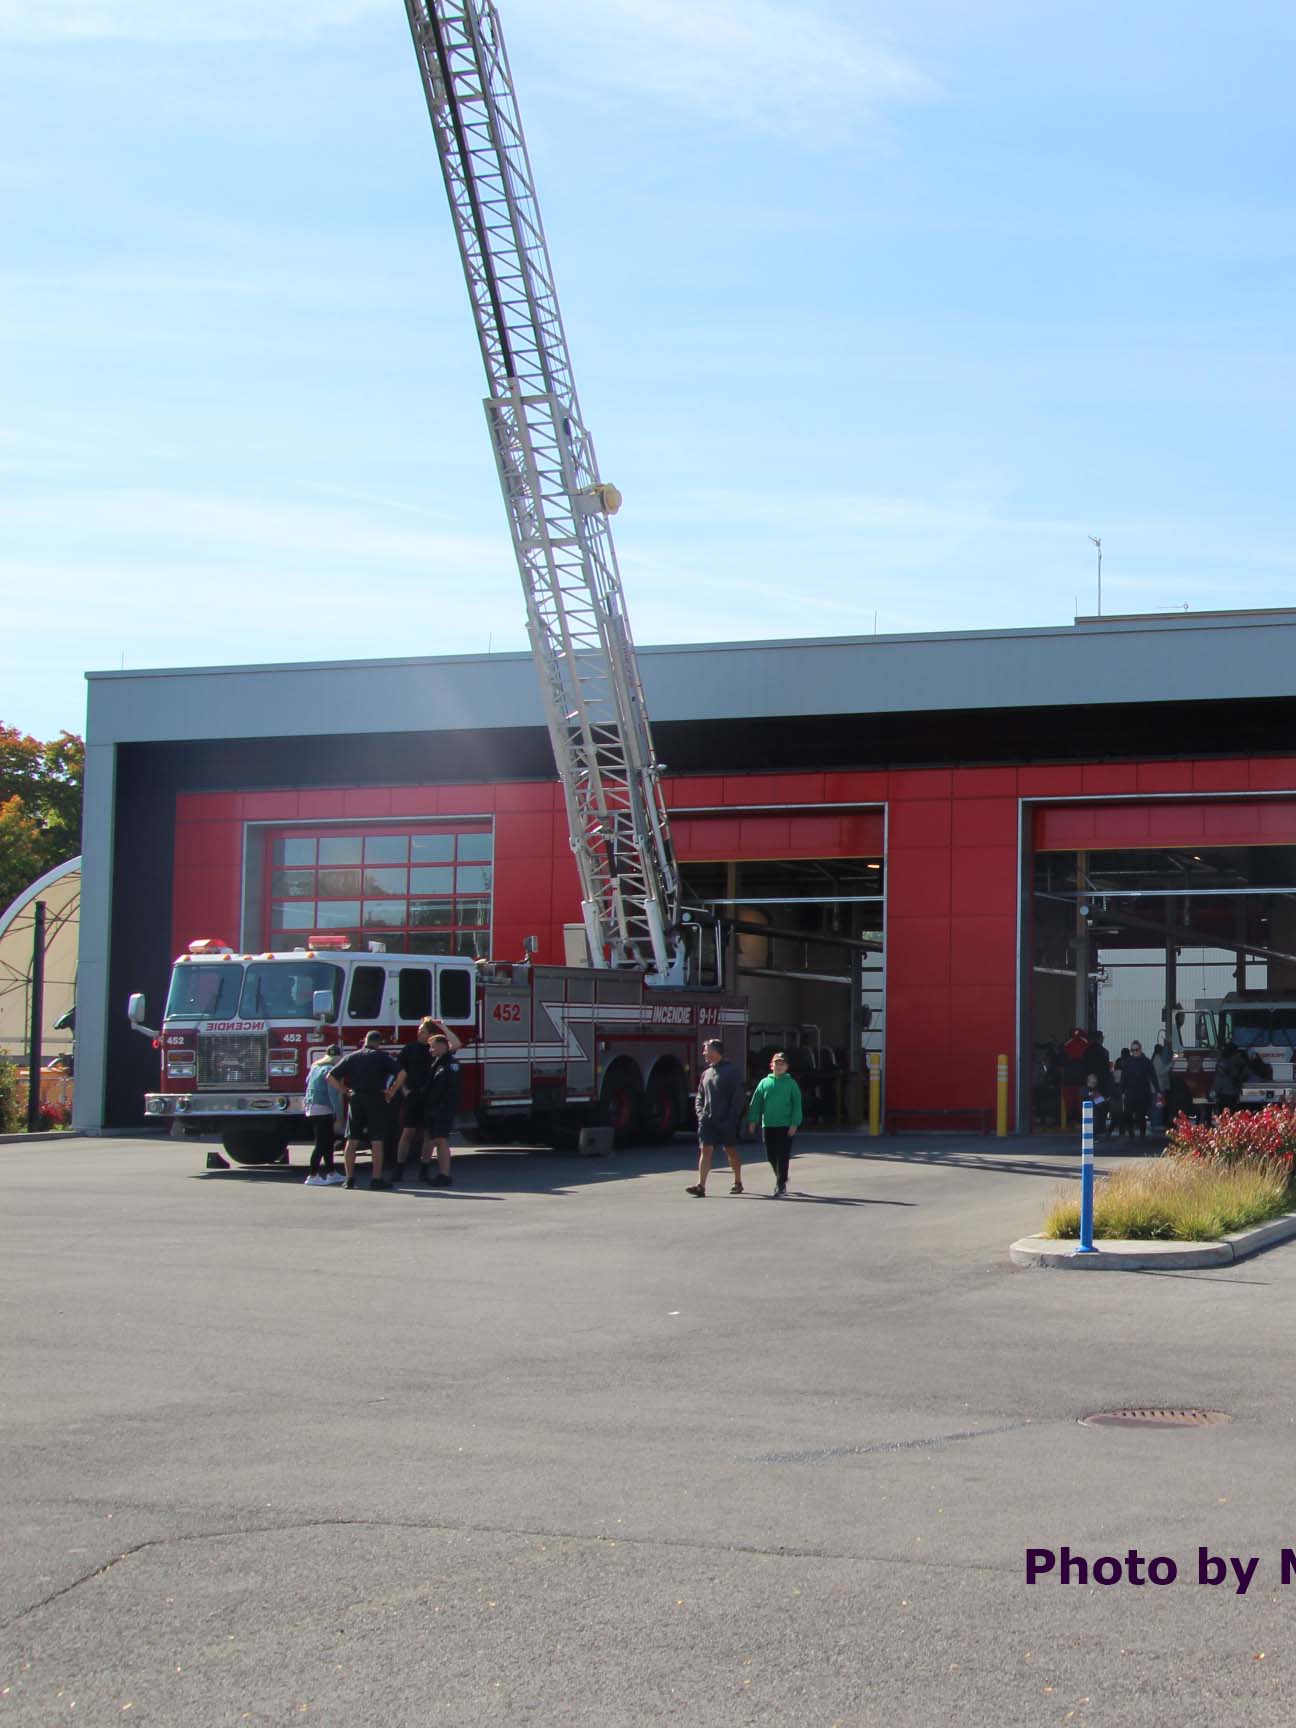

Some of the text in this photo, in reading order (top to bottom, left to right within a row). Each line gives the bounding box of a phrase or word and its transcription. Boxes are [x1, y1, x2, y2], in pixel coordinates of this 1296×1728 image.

[493, 1003, 520, 1022] 452
[652, 1006, 691, 1024] INCENDIE
[167, 1036, 185, 1045] 452
[283, 1033, 302, 1043] 452
